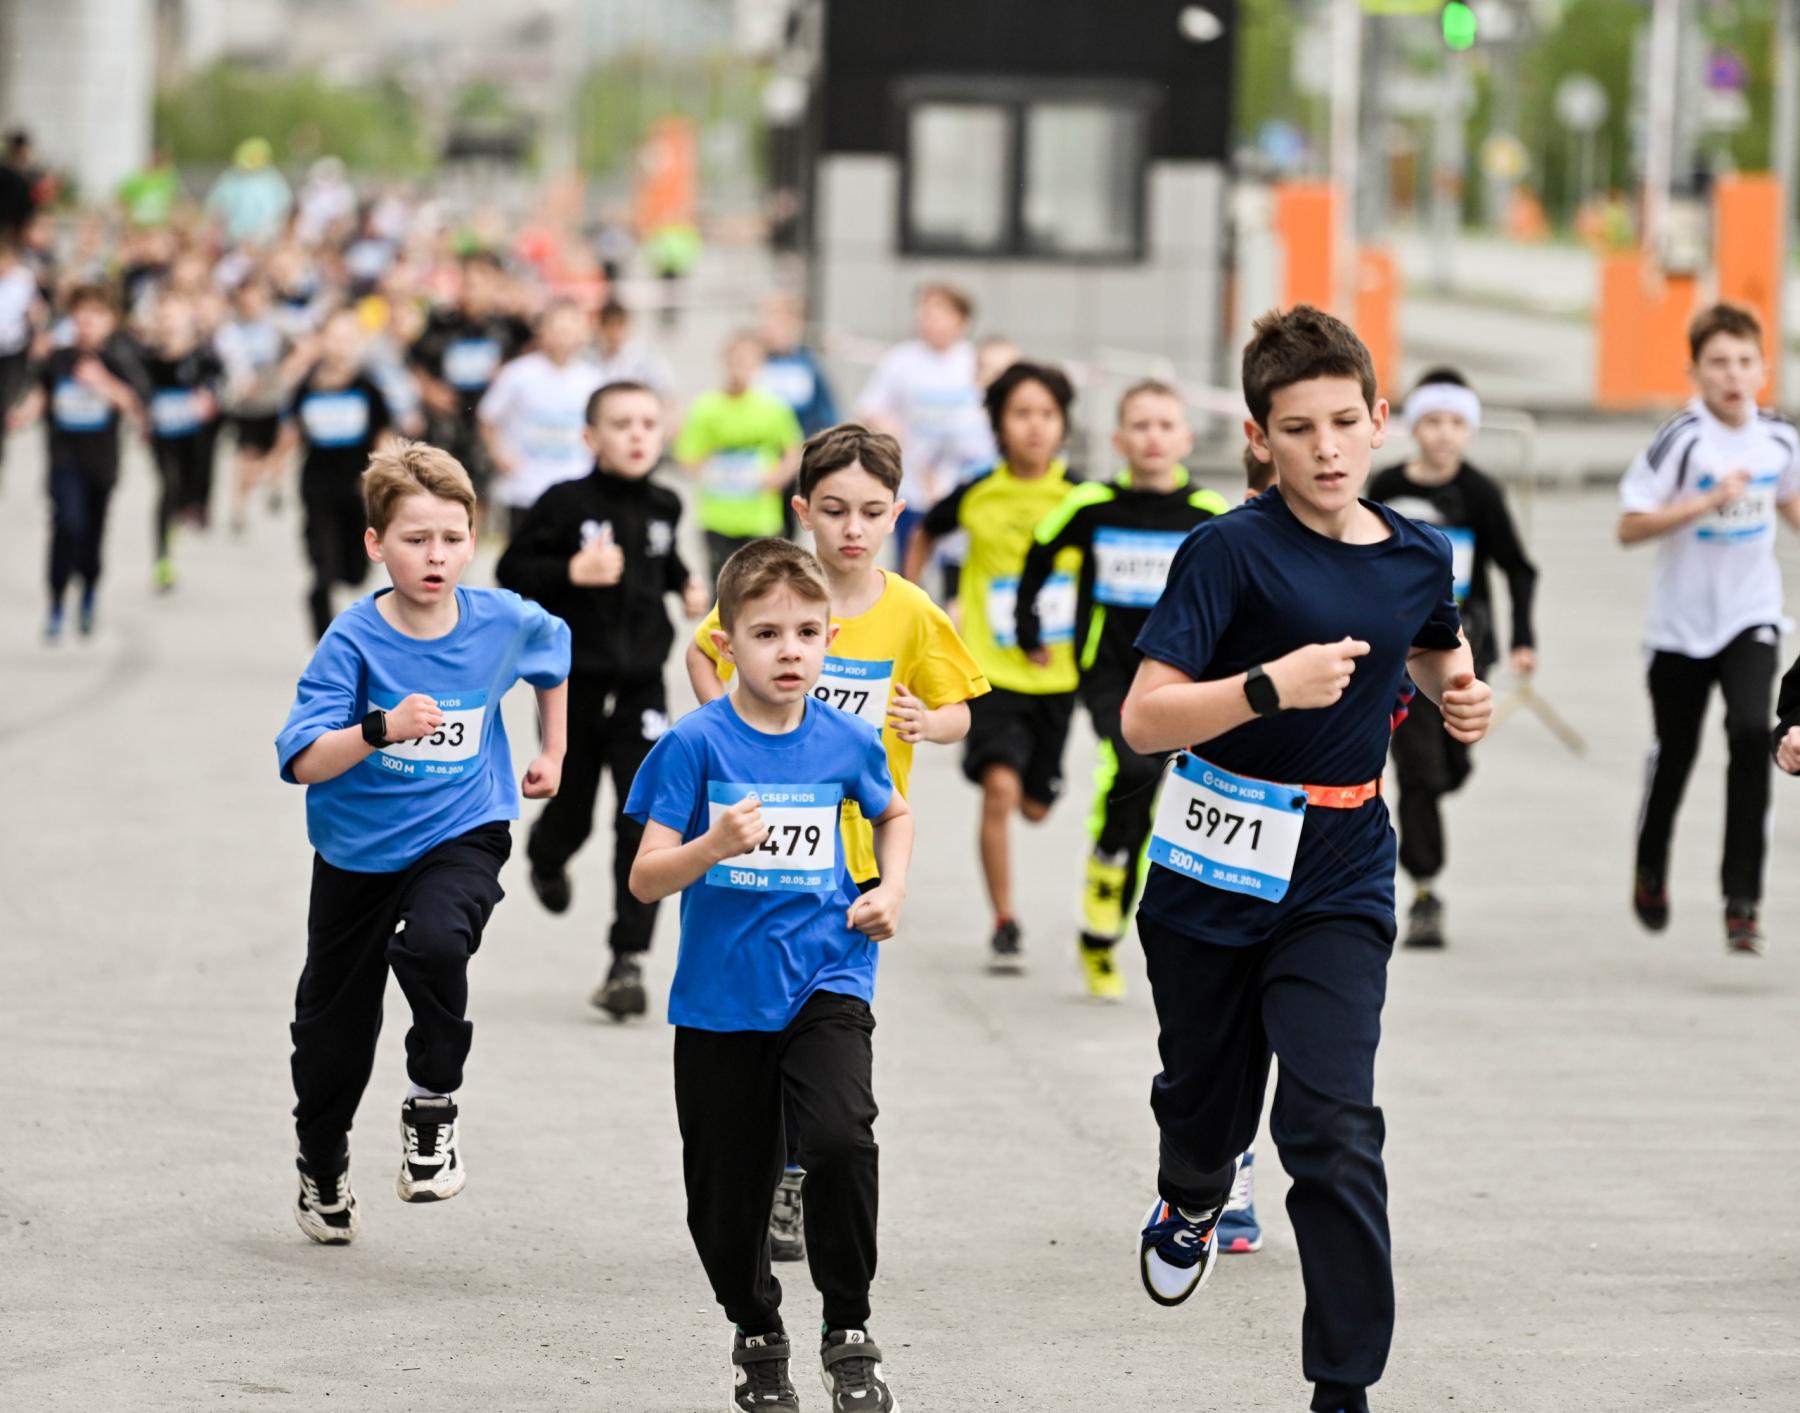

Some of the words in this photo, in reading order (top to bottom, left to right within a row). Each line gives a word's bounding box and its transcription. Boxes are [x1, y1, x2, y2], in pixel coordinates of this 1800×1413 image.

[844, 667, 867, 676] KIDS
[439, 699, 461, 707] KIDS
[805, 686, 869, 714] 977
[397, 722, 464, 747] 53
[381, 755, 403, 771] 500
[791, 793, 816, 802] KIDS
[1237, 786, 1266, 800] KIDS
[1185, 798, 1263, 851] 5971
[743, 825, 821, 856] 479
[1169, 848, 1193, 871] 500
[730, 869, 756, 886] 500
[1212, 868, 1262, 889] 30.05.2026
